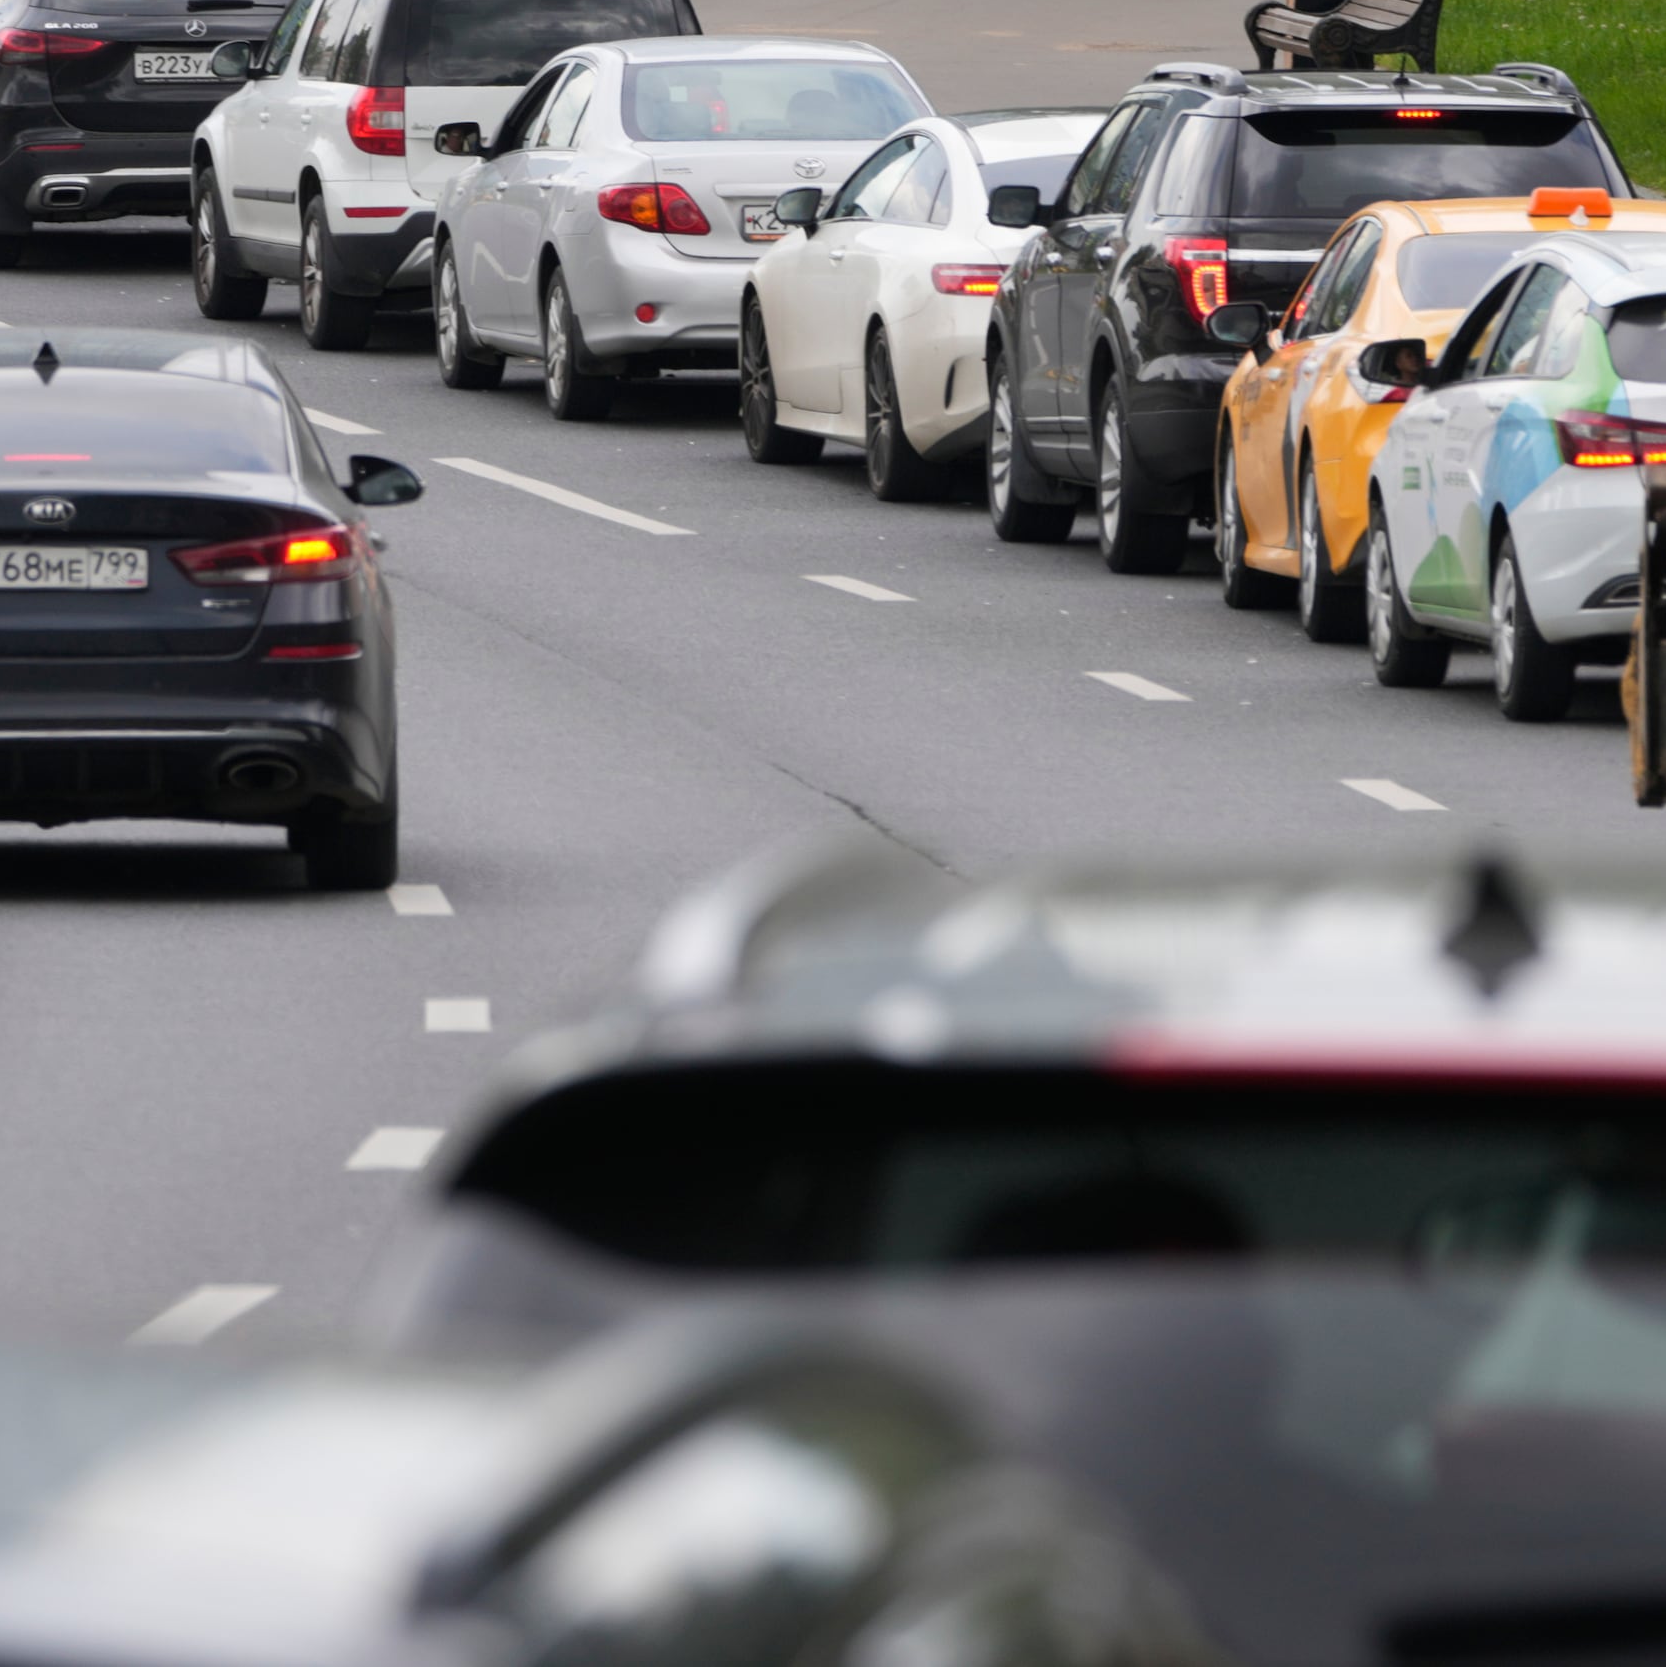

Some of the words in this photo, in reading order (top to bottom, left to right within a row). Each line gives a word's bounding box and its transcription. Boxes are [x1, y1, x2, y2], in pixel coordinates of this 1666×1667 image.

[73, 22, 99, 30] 200
[30, 502, 68, 519] KIA
[91, 551, 140, 576] 799
